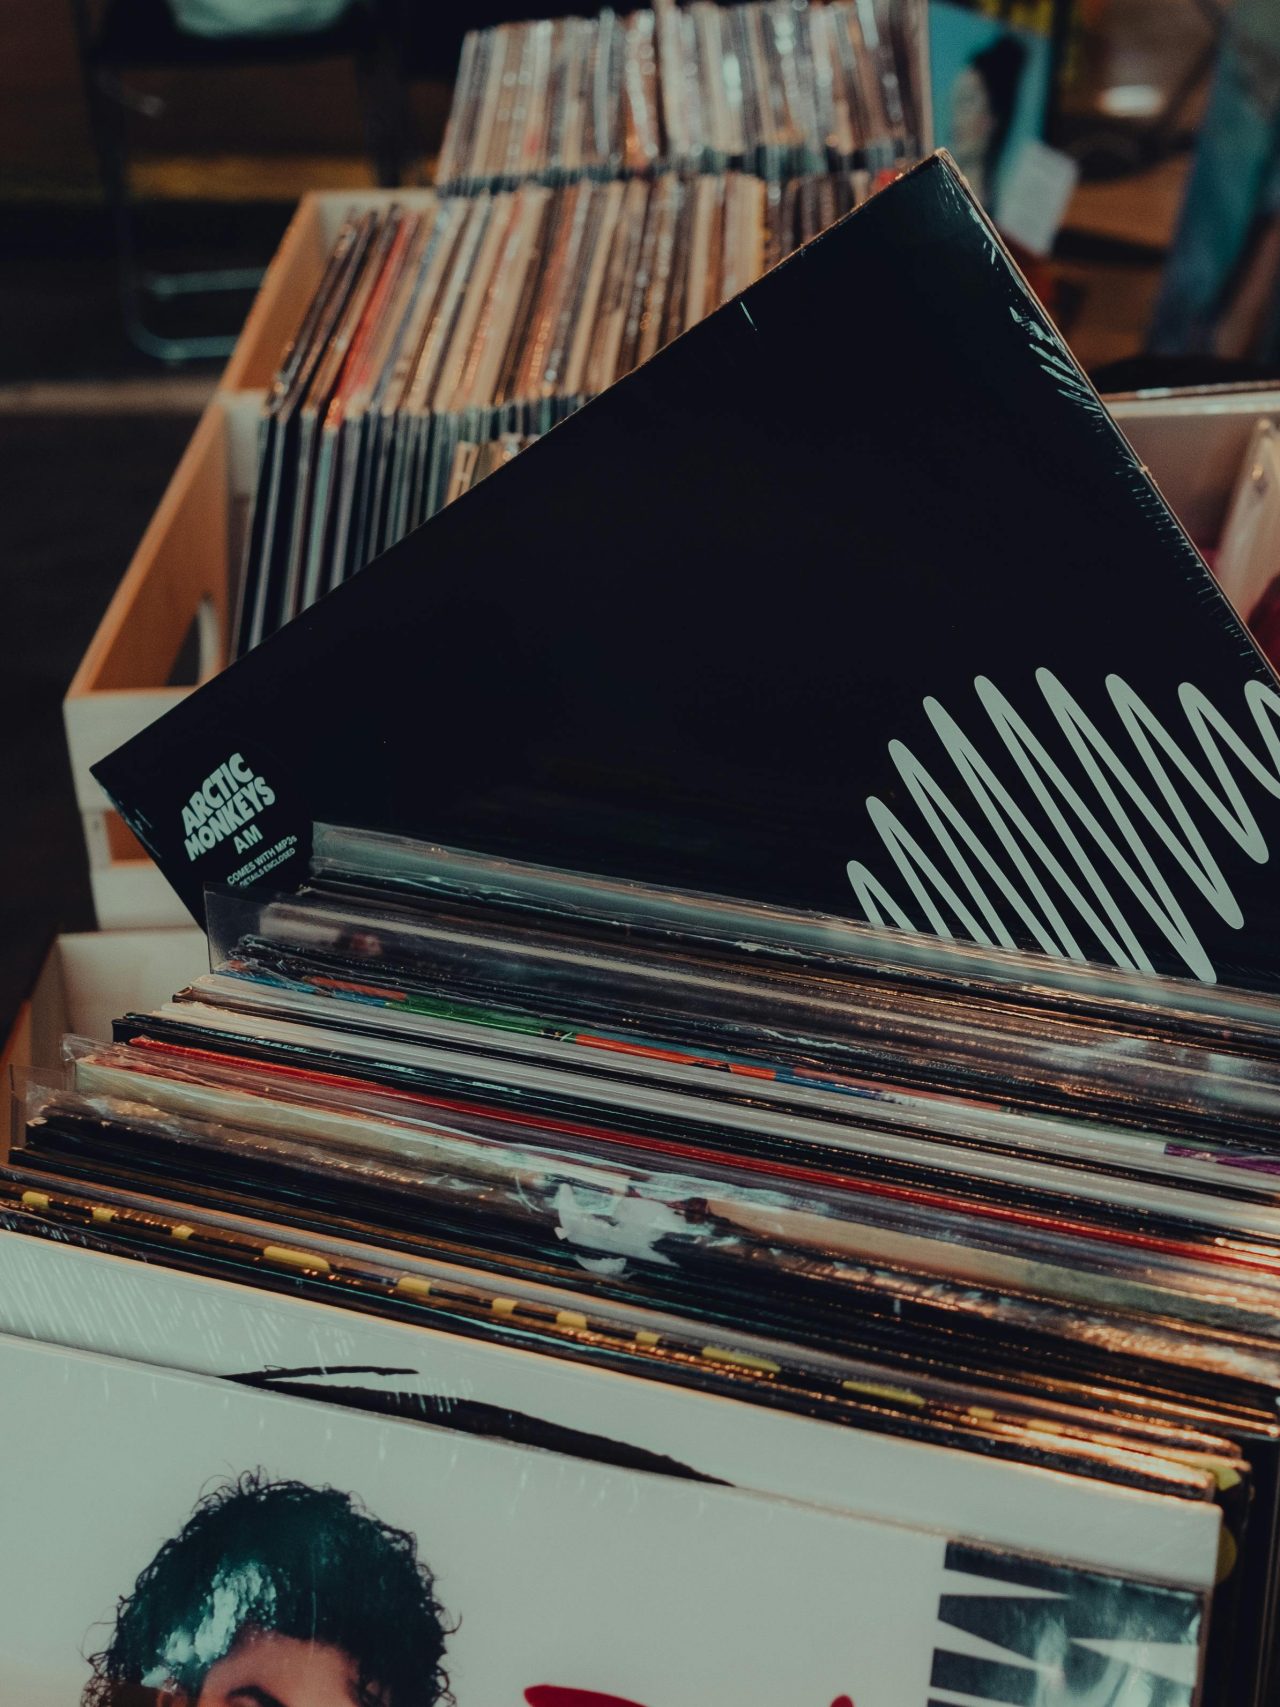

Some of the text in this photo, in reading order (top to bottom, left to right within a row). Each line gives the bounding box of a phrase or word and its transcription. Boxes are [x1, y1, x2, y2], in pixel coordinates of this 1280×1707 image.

[181, 752, 254, 836] ARCTIC
[184, 776, 275, 862] MONKEYS
[227, 835, 298, 886] COMES WITH MP3s
[233, 824, 263, 854] AM
[263, 847, 296, 872] ENCLOSED
